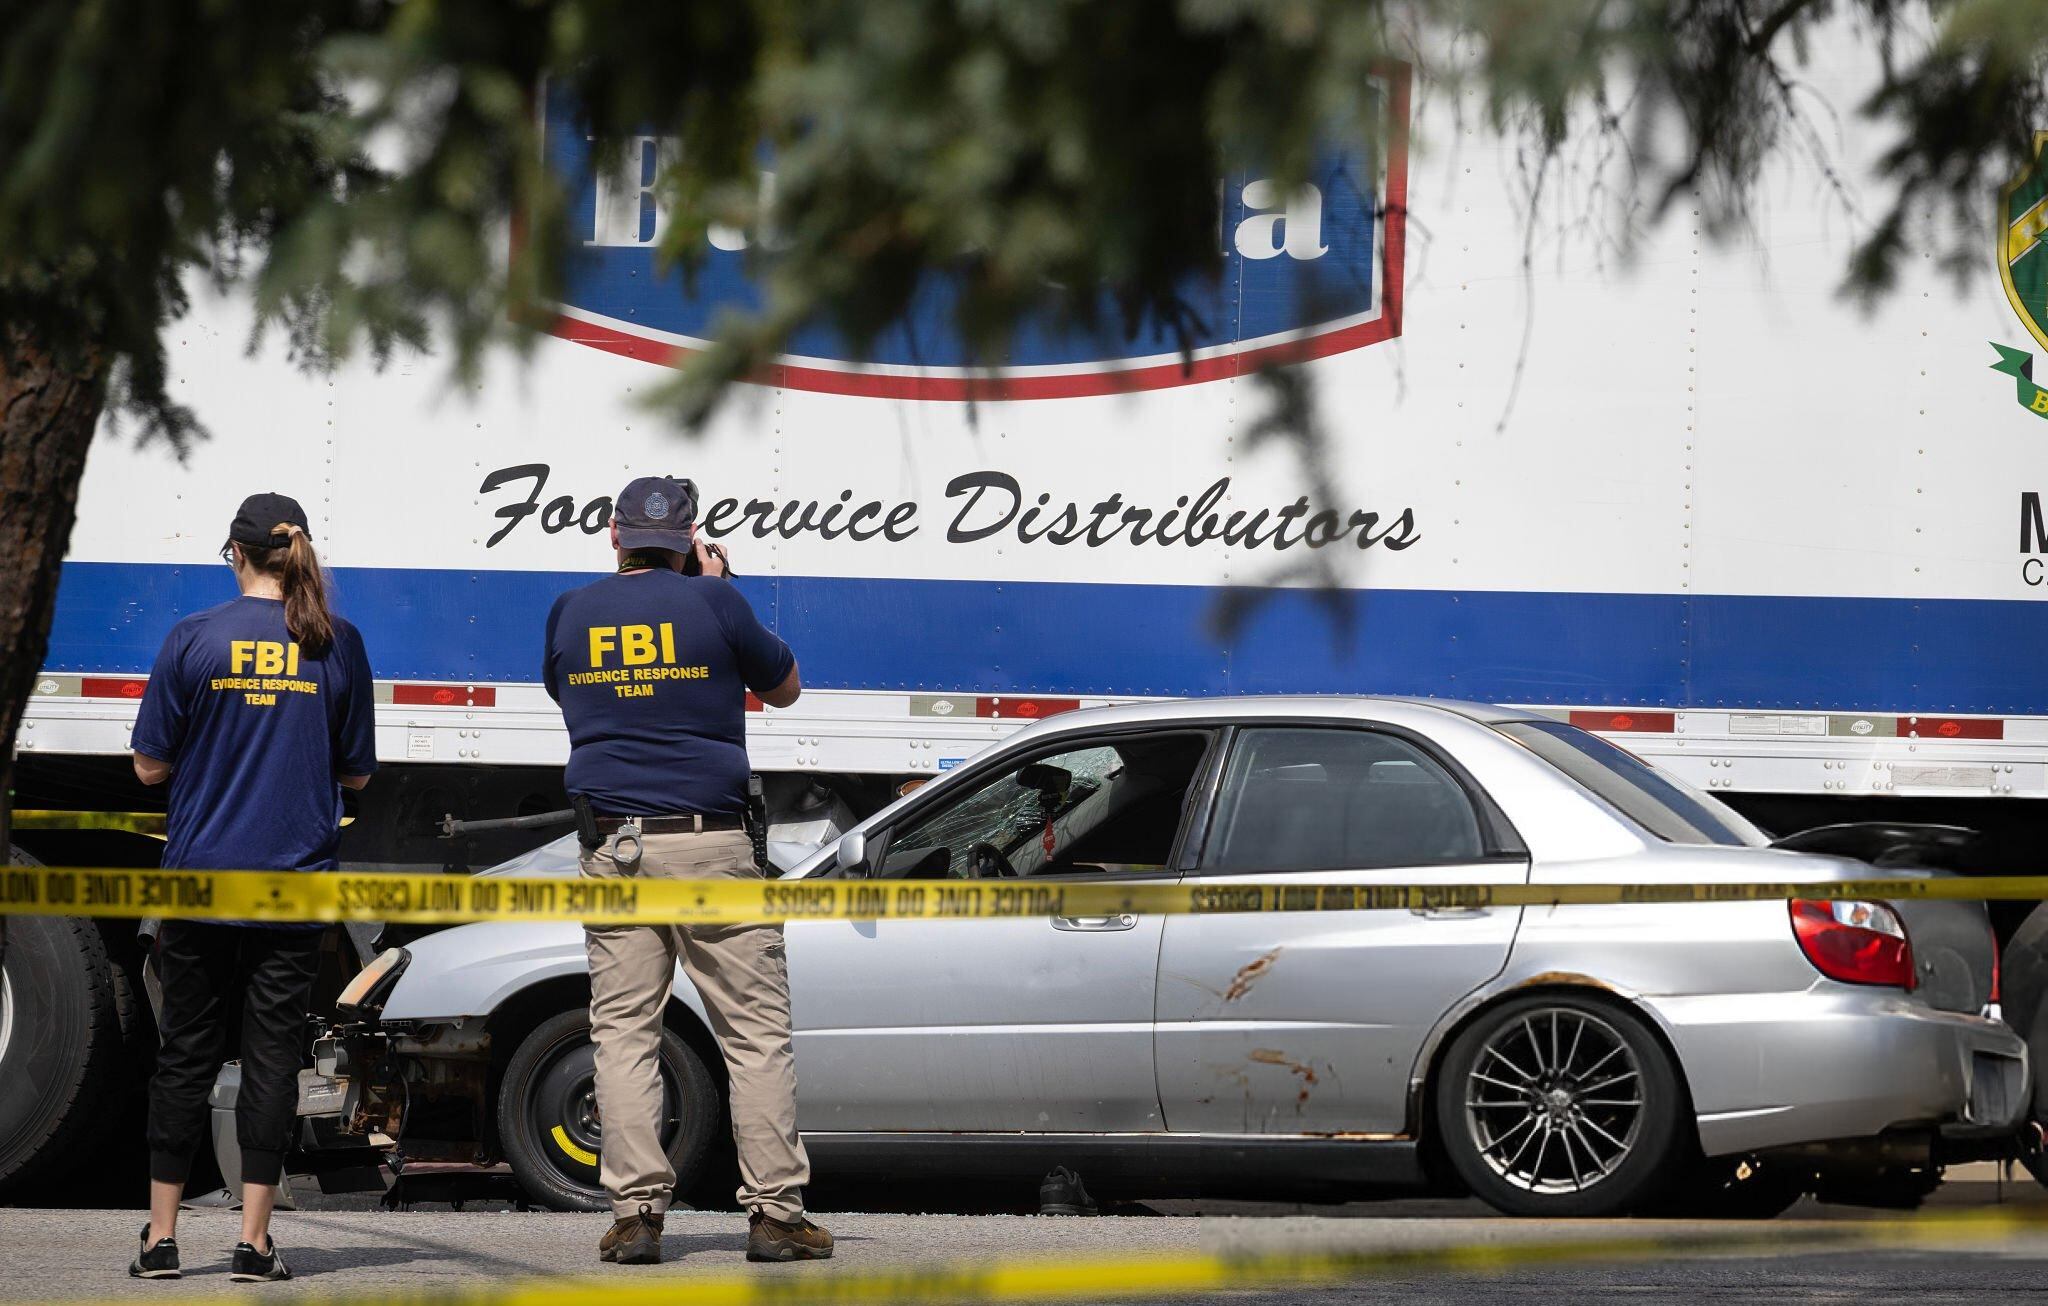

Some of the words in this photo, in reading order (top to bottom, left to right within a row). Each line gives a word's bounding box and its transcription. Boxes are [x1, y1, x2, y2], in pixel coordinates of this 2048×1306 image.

[480, 463, 919, 549] Fooervice
[945, 470, 1421, 551] Distributors
[2022, 558, 2048, 586] C
[231, 640, 300, 675] FBI
[588, 622, 677, 668] FBI
[211, 678, 260, 691] EVIDENCE
[262, 679, 318, 694] RESPONSE
[568, 669, 630, 685] EVIDENCE
[634, 666, 709, 681] RESPONSE
[615, 684, 654, 697] TEAM
[244, 693, 276, 705] TEAM
[82, 874, 132, 906] LINE
[139, 875, 214, 908] POLICE
[337, 879, 411, 911] CROSS
[418, 880, 461, 912] NOT
[471, 880, 500, 913] DO
[509, 881, 556, 914] LINE
[561, 882, 638, 915] POLICE
[762, 887, 835, 916] CROSS
[846, 887, 889, 916] NOT
[897, 887, 925, 916] DO
[932, 887, 981, 915] LINE
[989, 887, 1065, 915] POLICE
